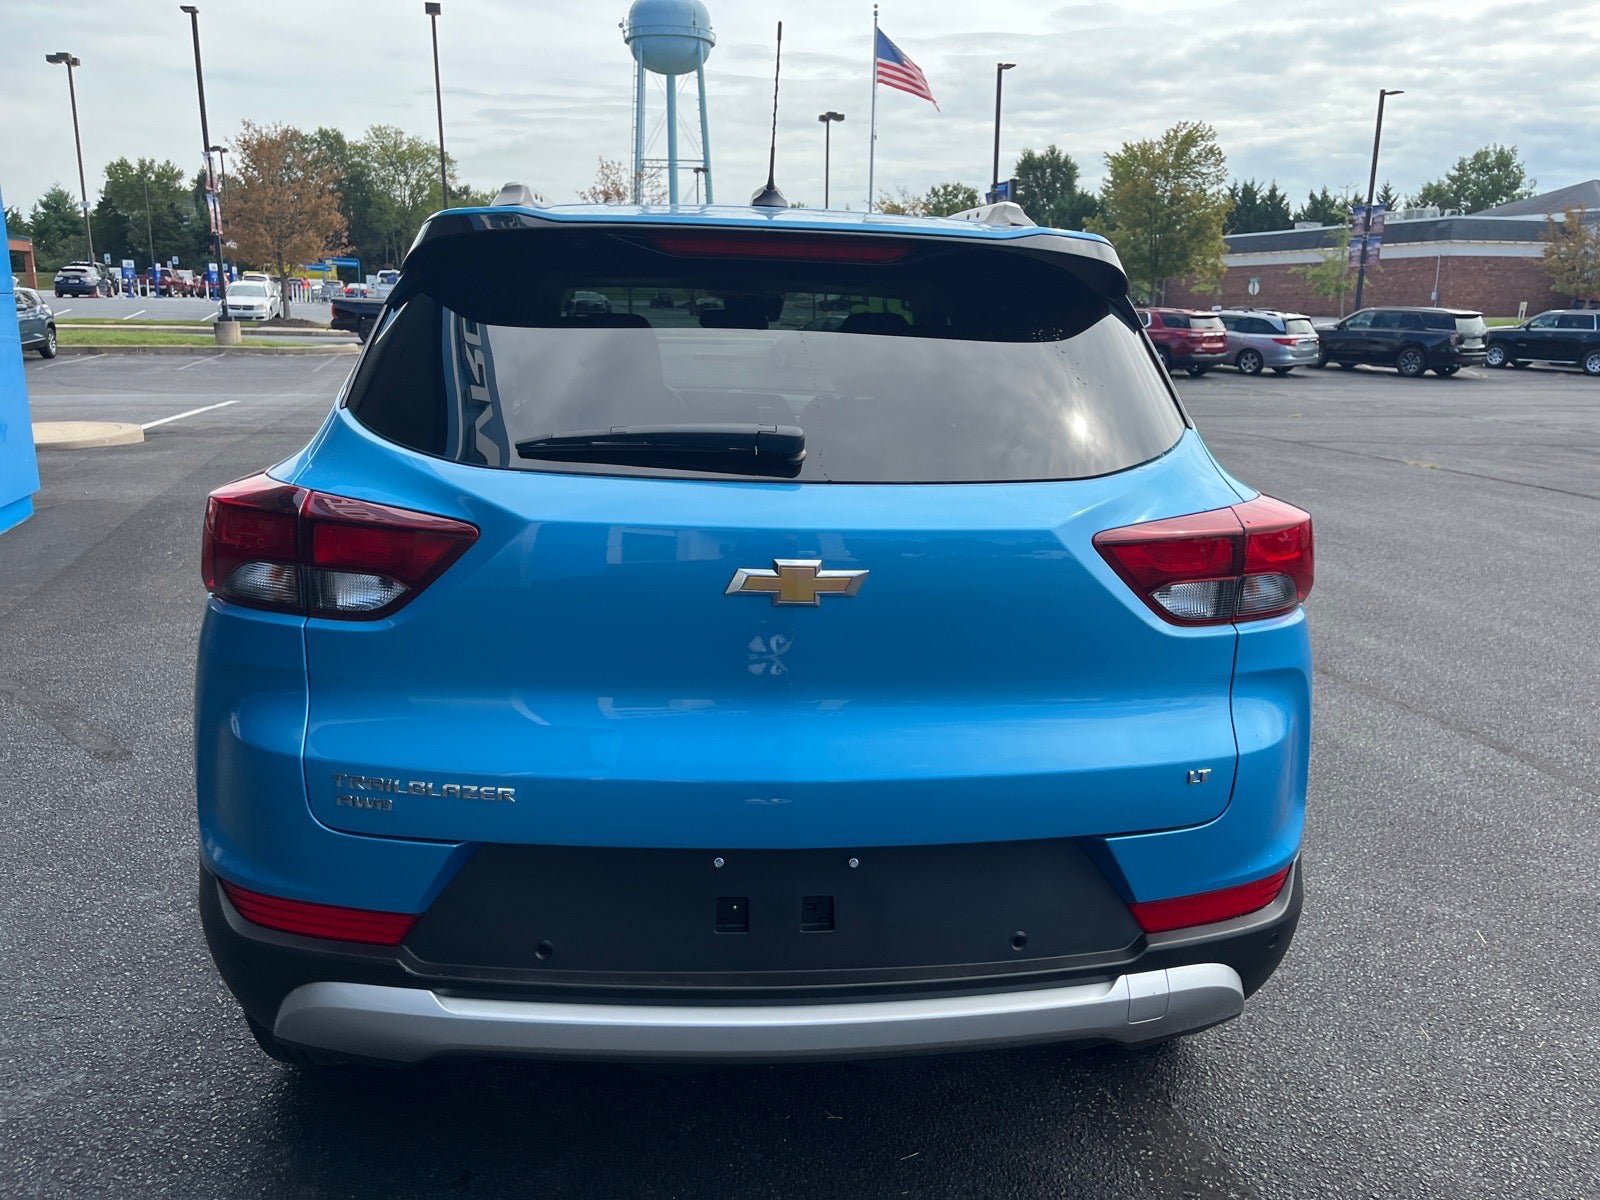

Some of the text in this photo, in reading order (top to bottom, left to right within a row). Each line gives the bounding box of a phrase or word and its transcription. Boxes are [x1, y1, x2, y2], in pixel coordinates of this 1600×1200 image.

[1186, 768, 1212, 784] LT
[334, 773, 516, 802] TRAILBLAZER
[336, 795, 393, 811] AWD
